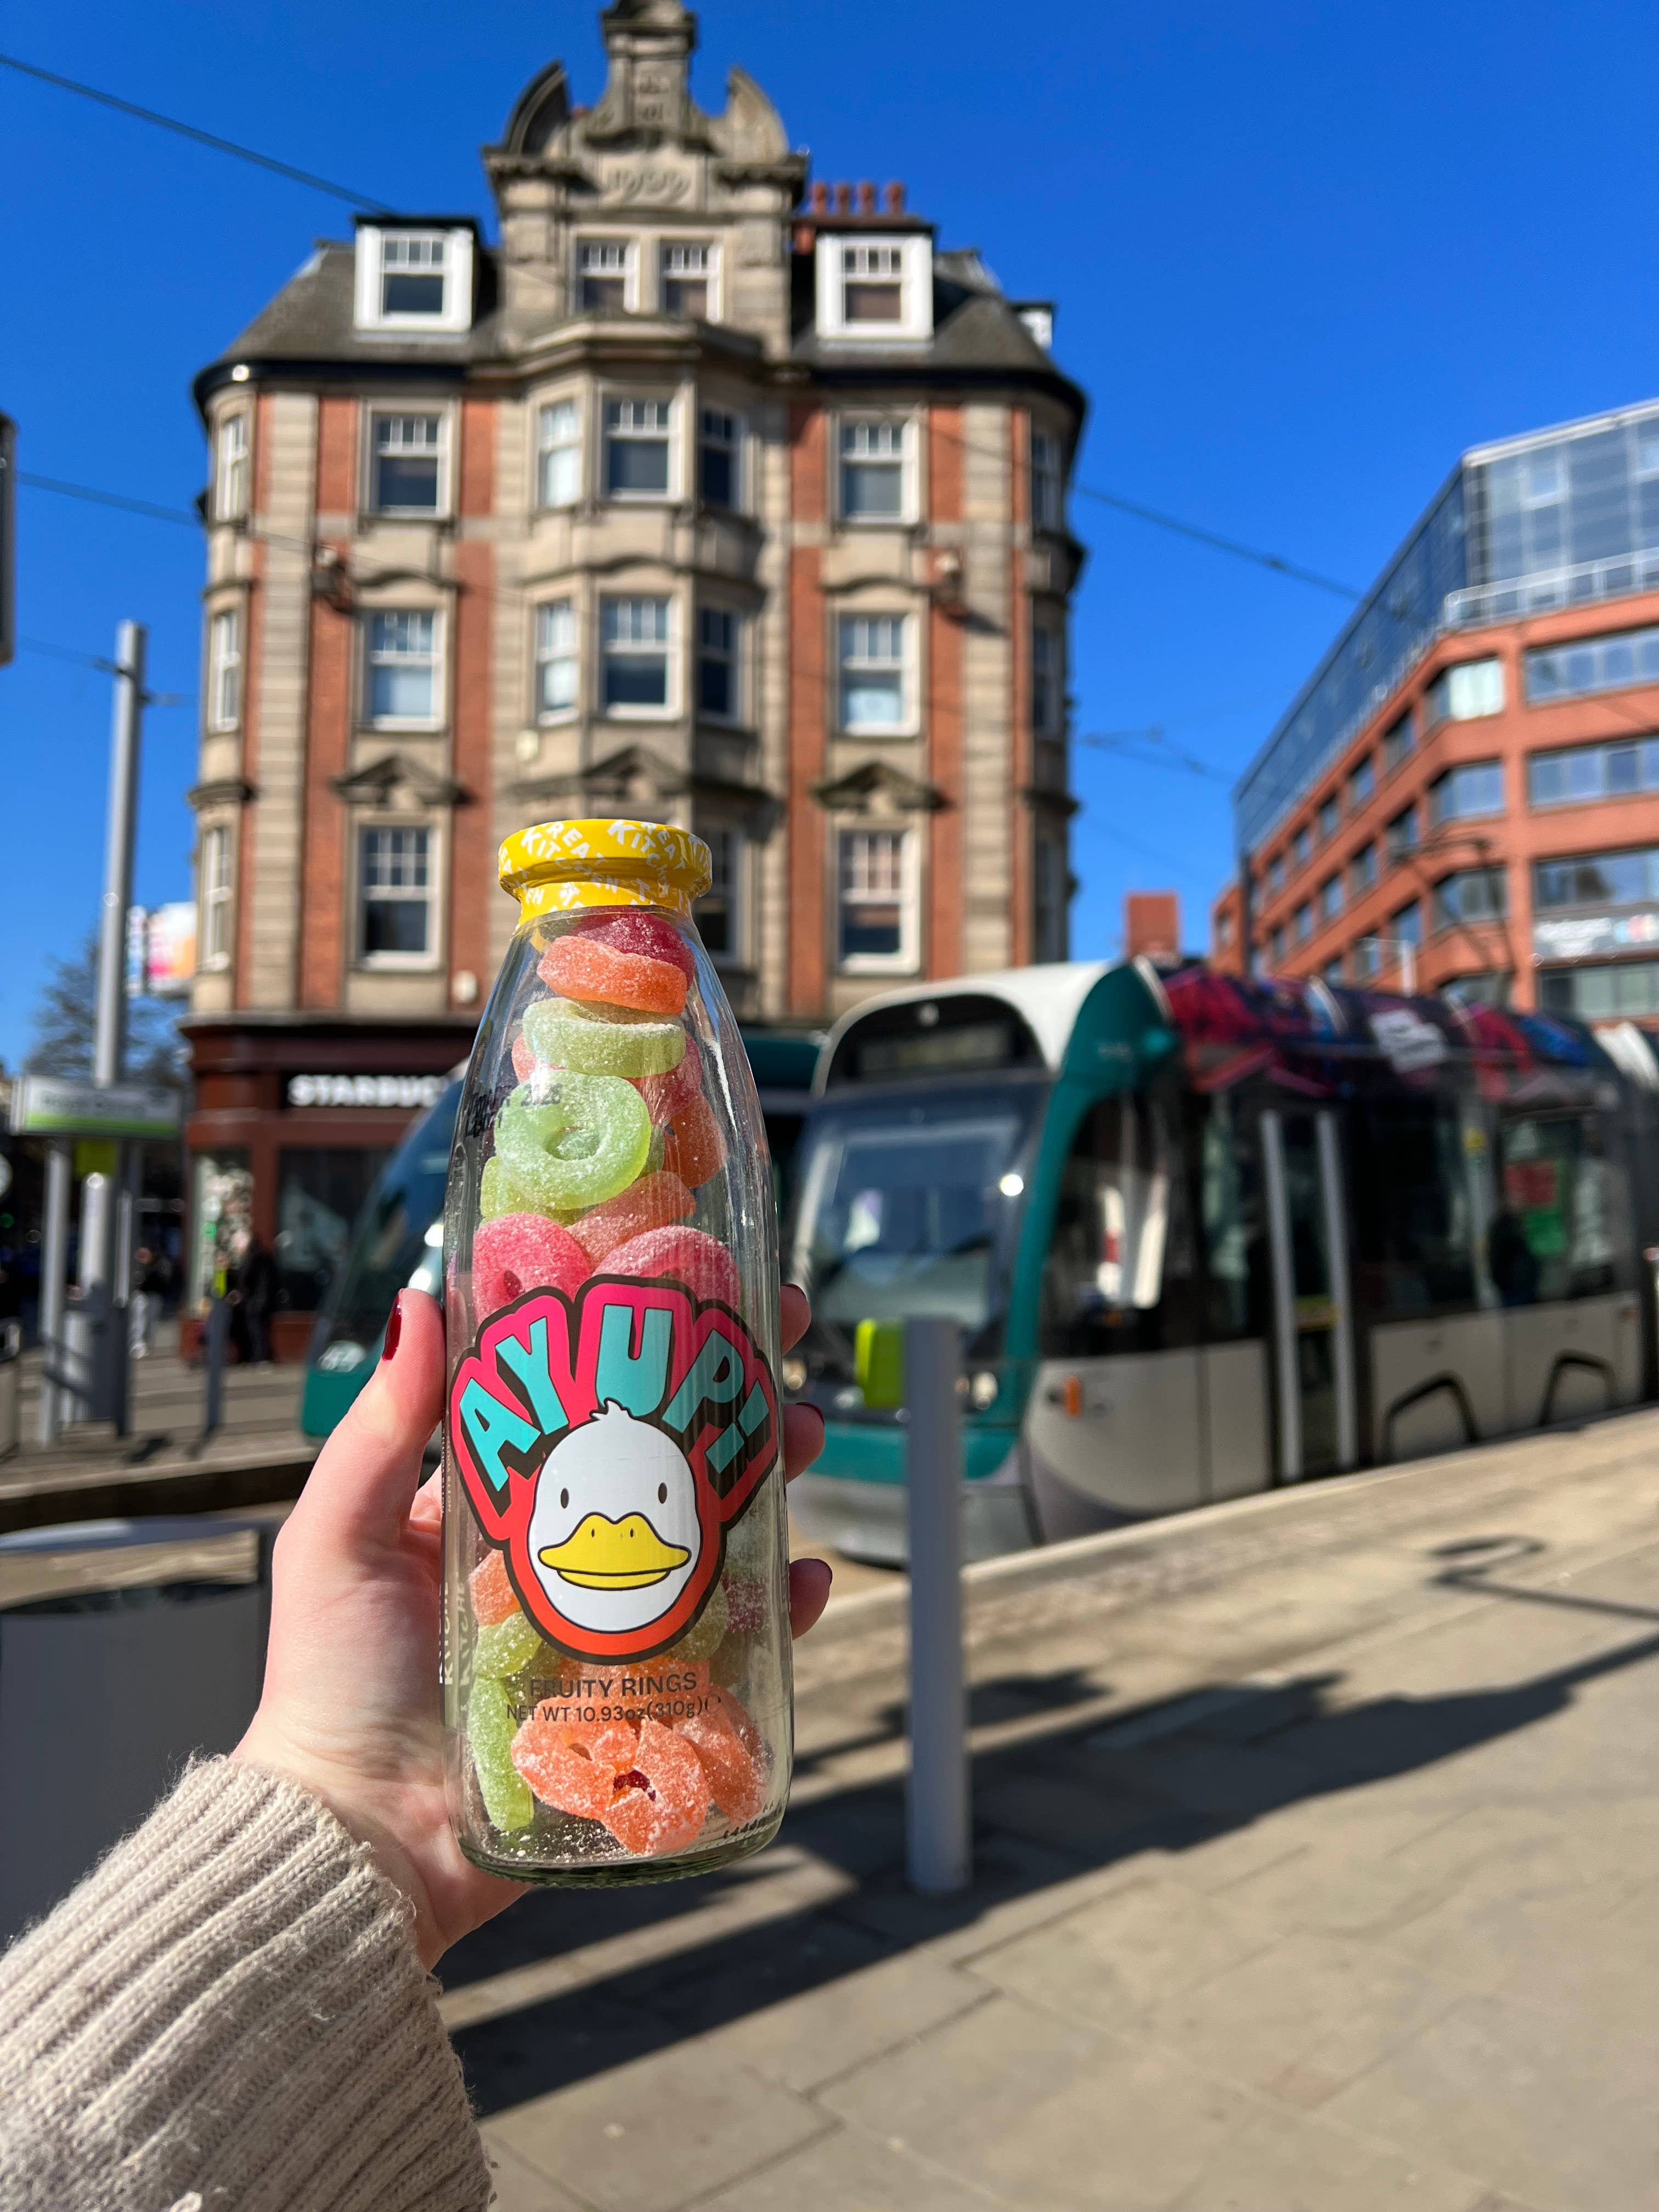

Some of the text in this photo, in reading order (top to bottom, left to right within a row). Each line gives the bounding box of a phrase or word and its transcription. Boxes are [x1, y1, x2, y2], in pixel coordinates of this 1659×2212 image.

[287, 1074, 451, 1108] STARBUC
[460, 1317, 571, 1492] AY
[596, 1305, 769, 1473] UP!
[530, 1672, 697, 1698] FRUITY RINGS
[507, 1704, 538, 1720] NET
[543, 1706, 571, 1722] WT
